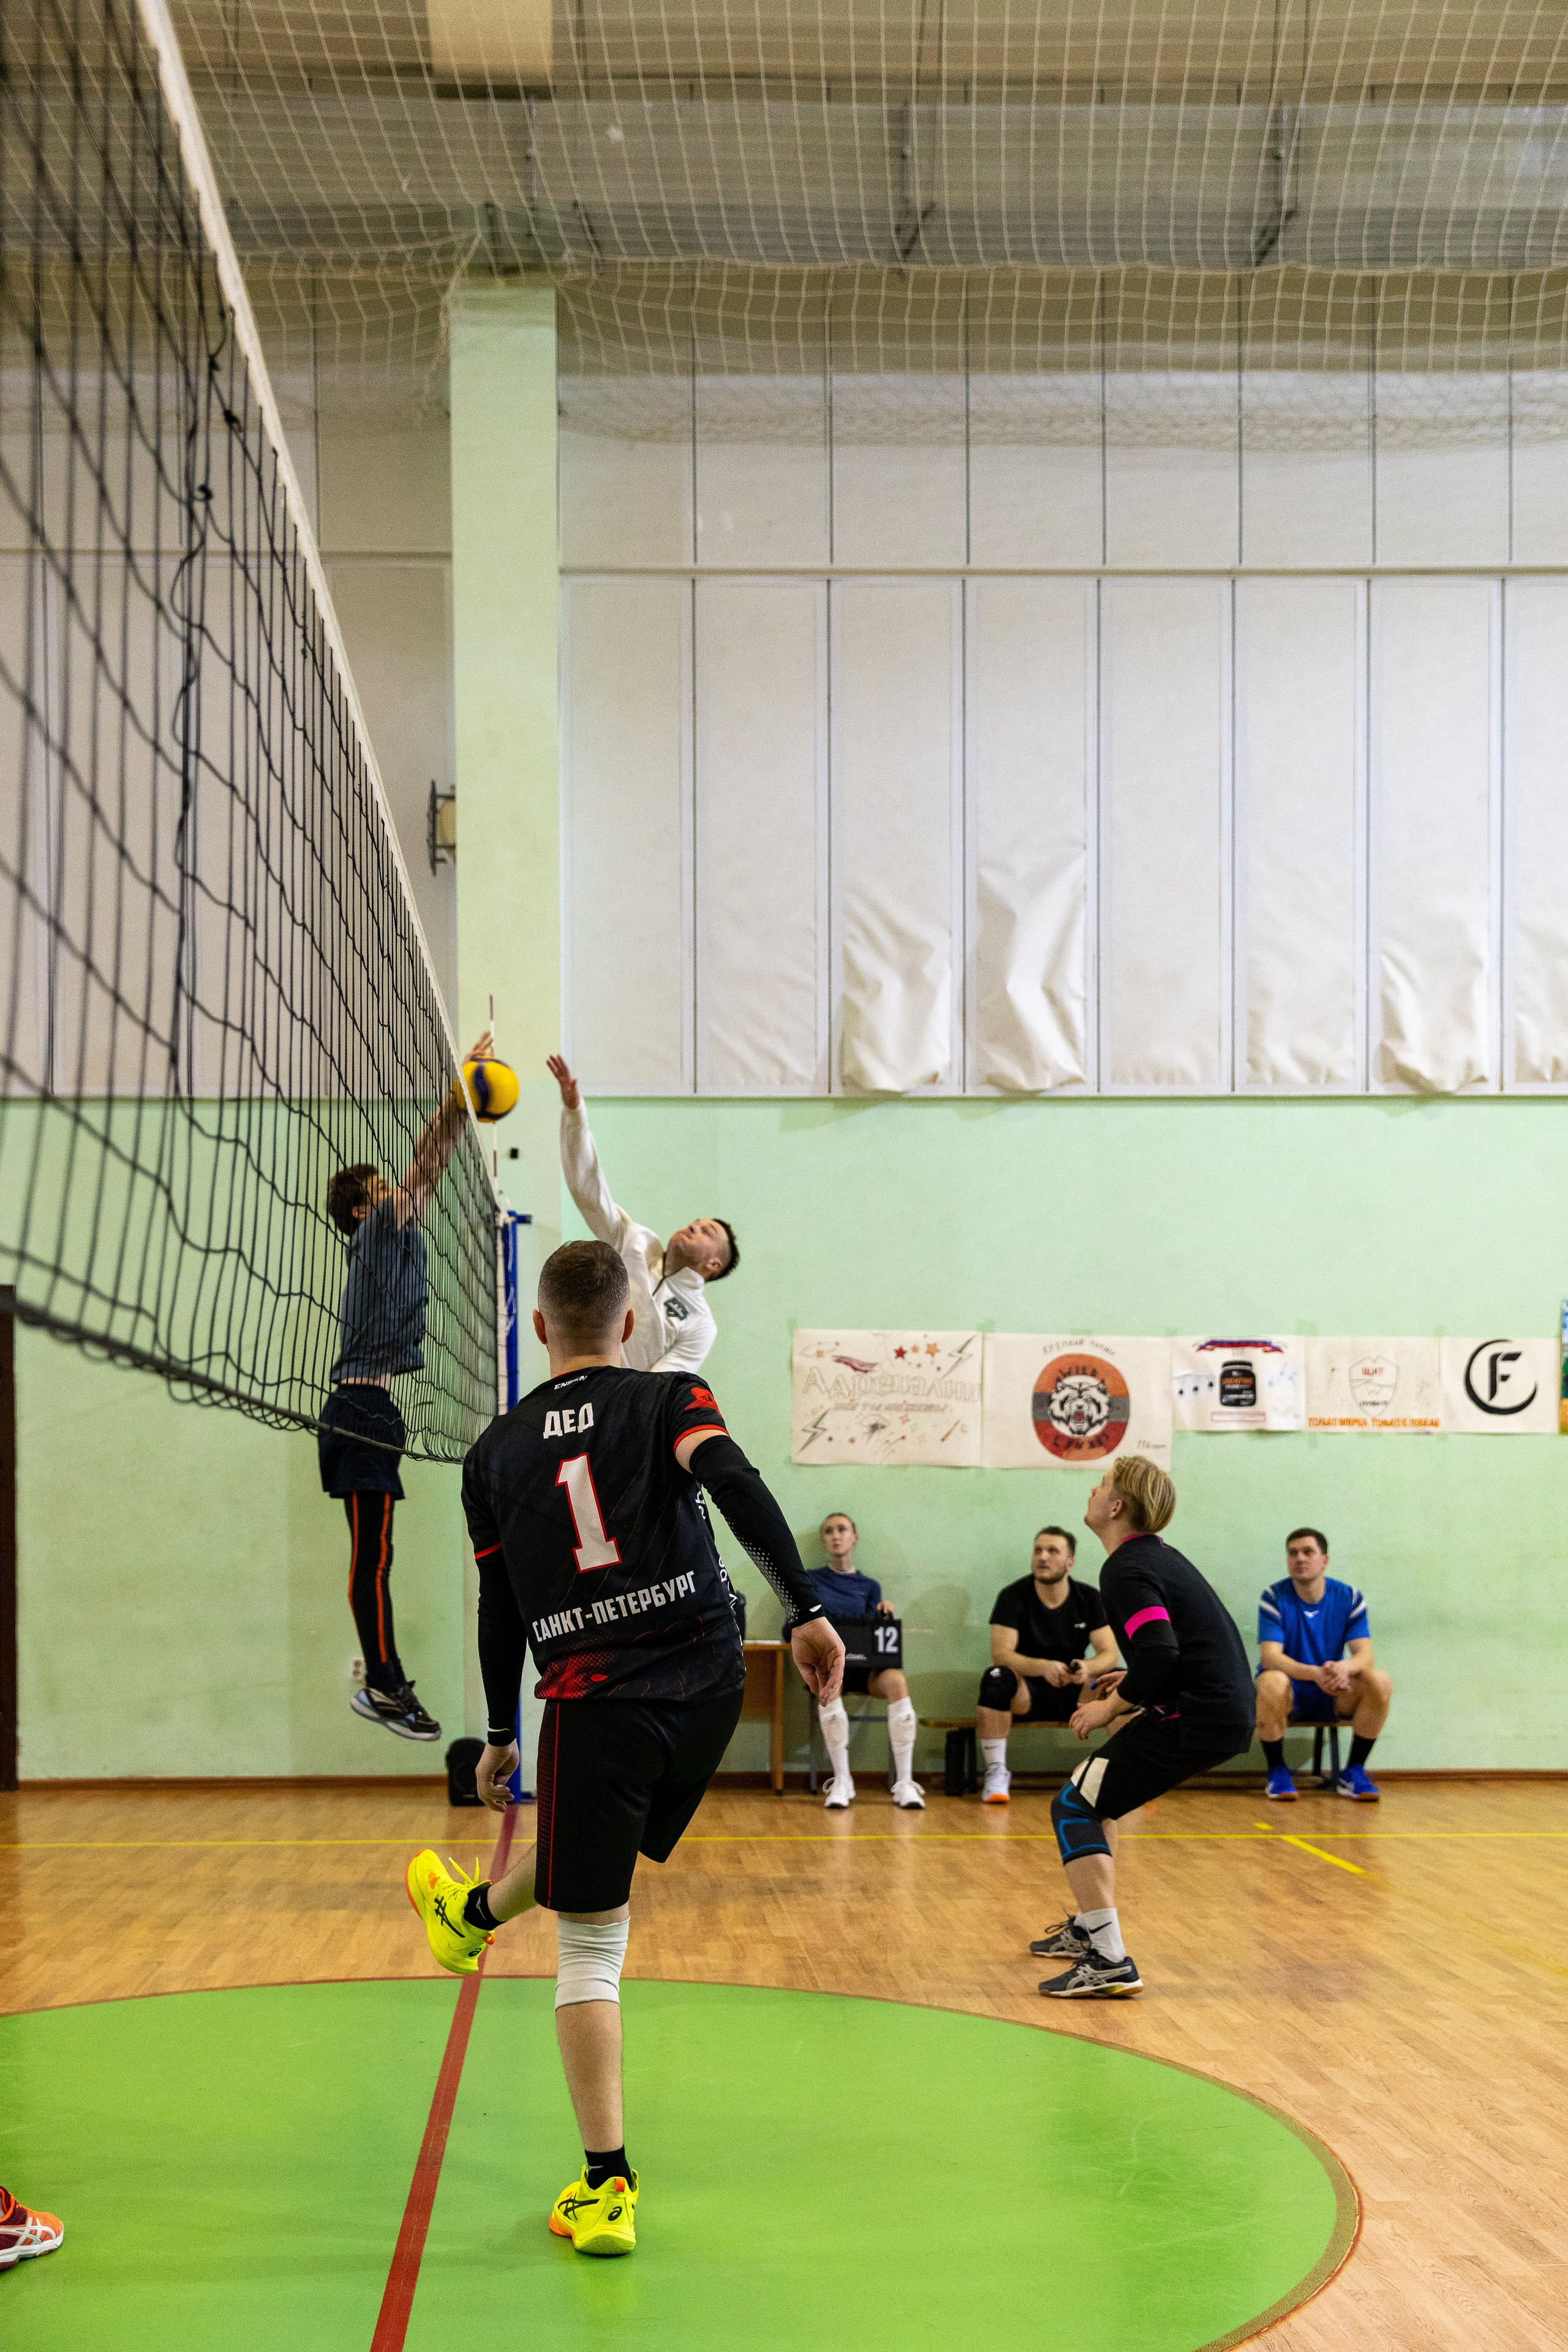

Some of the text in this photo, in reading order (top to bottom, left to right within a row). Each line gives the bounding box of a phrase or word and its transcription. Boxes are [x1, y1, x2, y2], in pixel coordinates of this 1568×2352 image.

[1362, 1367, 1384, 1376] ЩИТ
[543, 1403, 594, 1439] ДЕД
[555, 1453, 622, 1574] 1
[532, 1570, 696, 1642] САНКТ-ПЕТЕРБУРГ
[874, 1626, 899, 1653] 12
